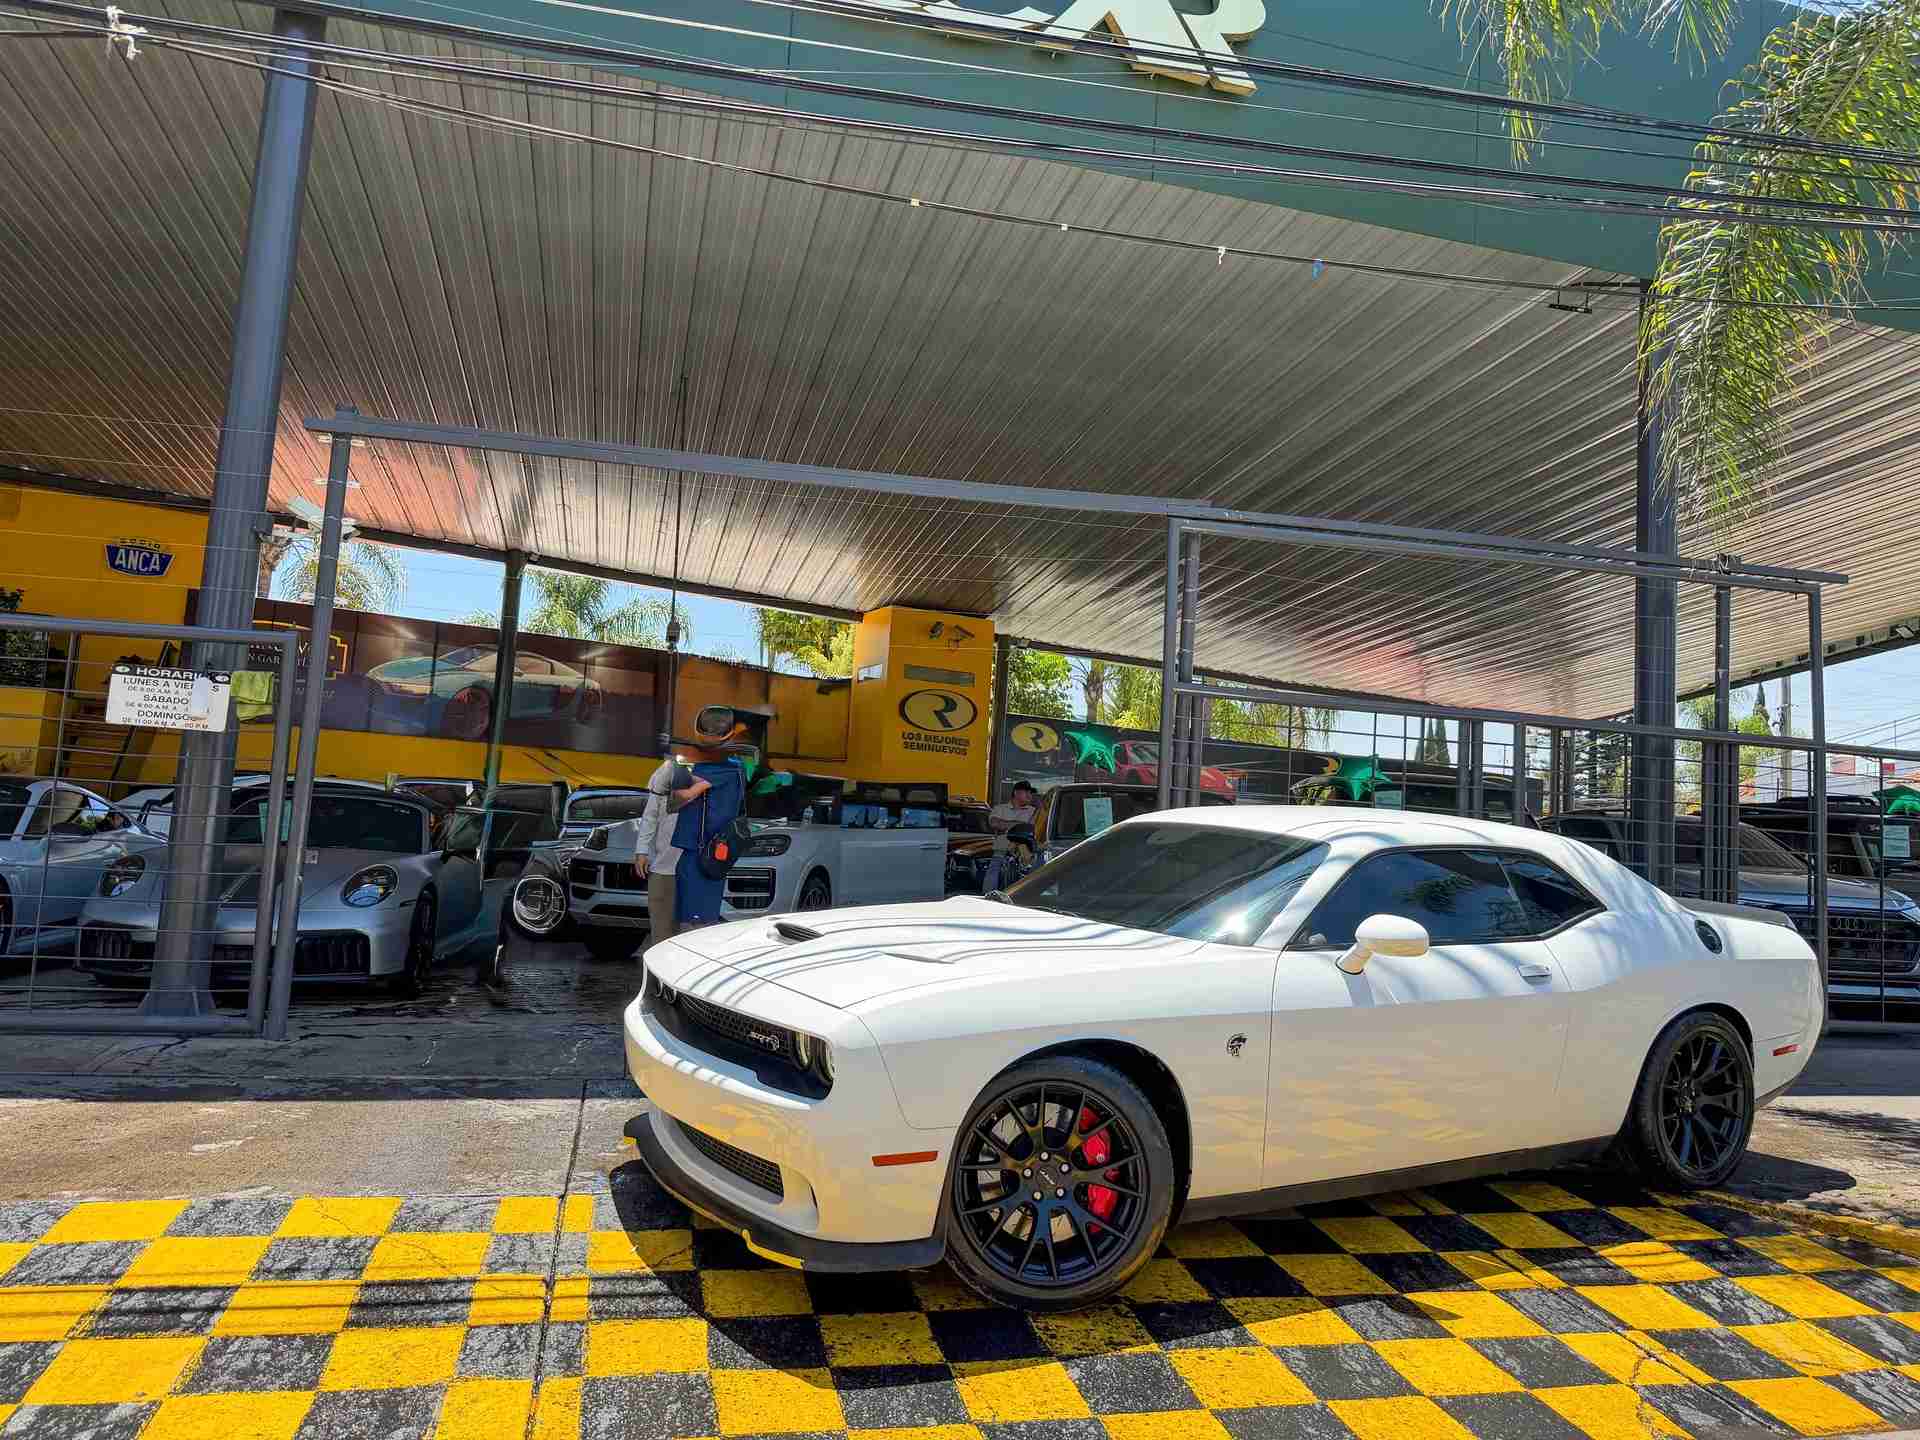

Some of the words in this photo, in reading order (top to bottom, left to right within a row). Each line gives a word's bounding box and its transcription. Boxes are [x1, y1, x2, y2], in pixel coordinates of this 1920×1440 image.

[115, 549, 161, 572] ANCA
[123, 676, 160, 688] LUNES
[162, 680, 170, 689] A
[902, 731, 921, 742] LOS
[924, 734, 971, 748] MEJORES
[903, 740, 969, 756] SEMINUEVOS
